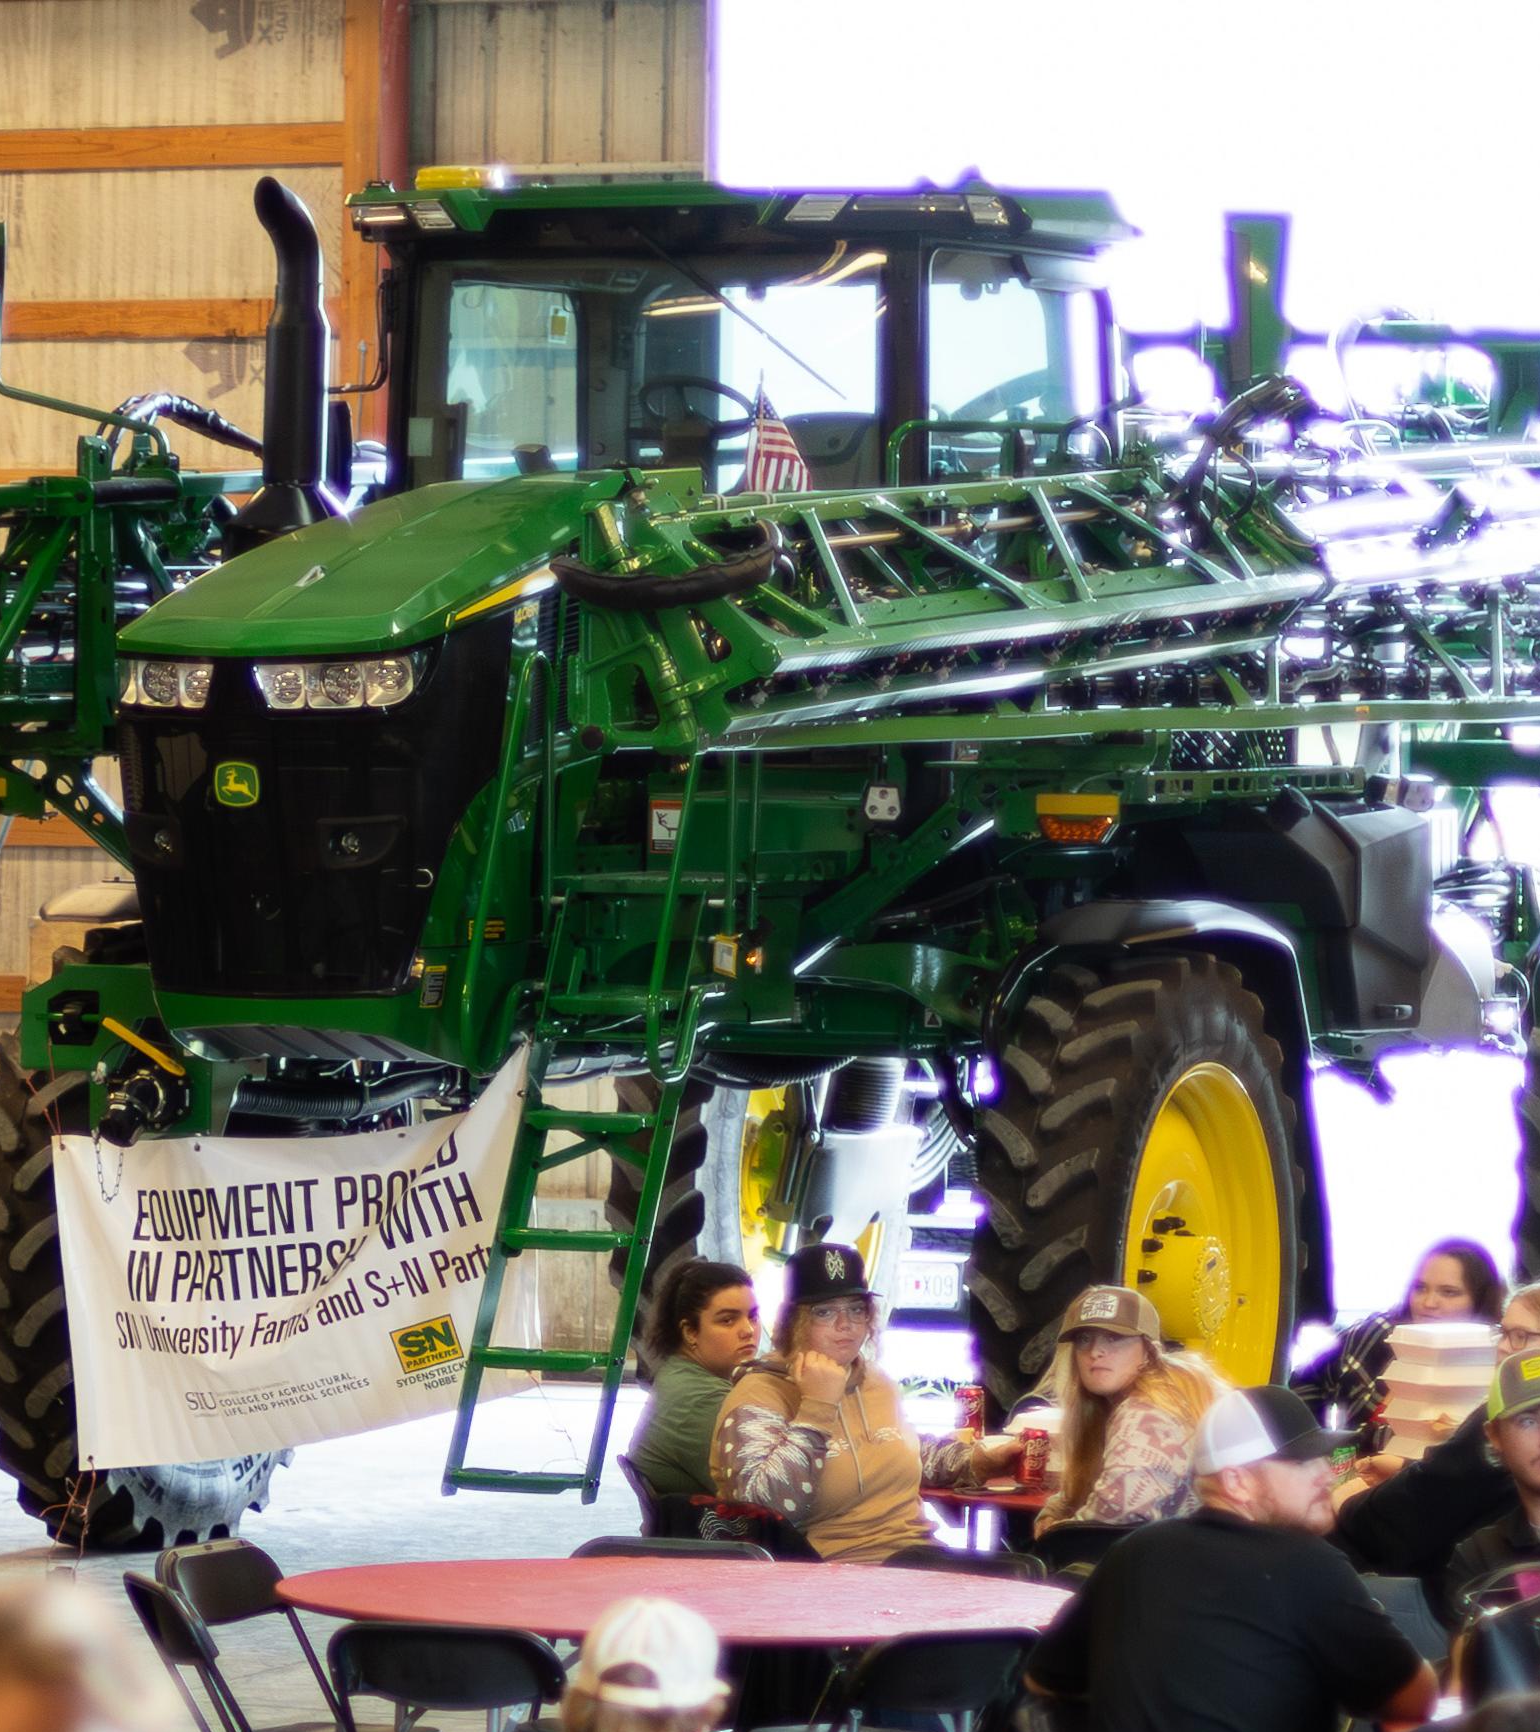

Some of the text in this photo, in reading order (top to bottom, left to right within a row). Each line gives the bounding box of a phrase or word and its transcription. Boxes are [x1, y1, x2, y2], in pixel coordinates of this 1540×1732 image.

[132, 1178, 319, 1242] EQUIPMENT
[127, 1250, 163, 1302] IN
[378, 1171, 483, 1250] WITH
[140, 1314, 245, 1360] University
[250, 1307, 310, 1348] Farms
[316, 1278, 364, 1325] and
[364, 1256, 429, 1307] S+N
[405, 1348, 459, 1369] PARTNERS
[396, 1360, 470, 1388] SYDENSTRICK
[423, 1374, 458, 1390] NOBBE
[185, 1391, 217, 1411] SIU
[218, 1394, 258, 1408] COLLEGE
[262, 1390, 276, 1401] OF
[248, 1403, 268, 1414] AND
[272, 1393, 318, 1409] PHYSICAL
[320, 1378, 370, 1398] SCIENCES
